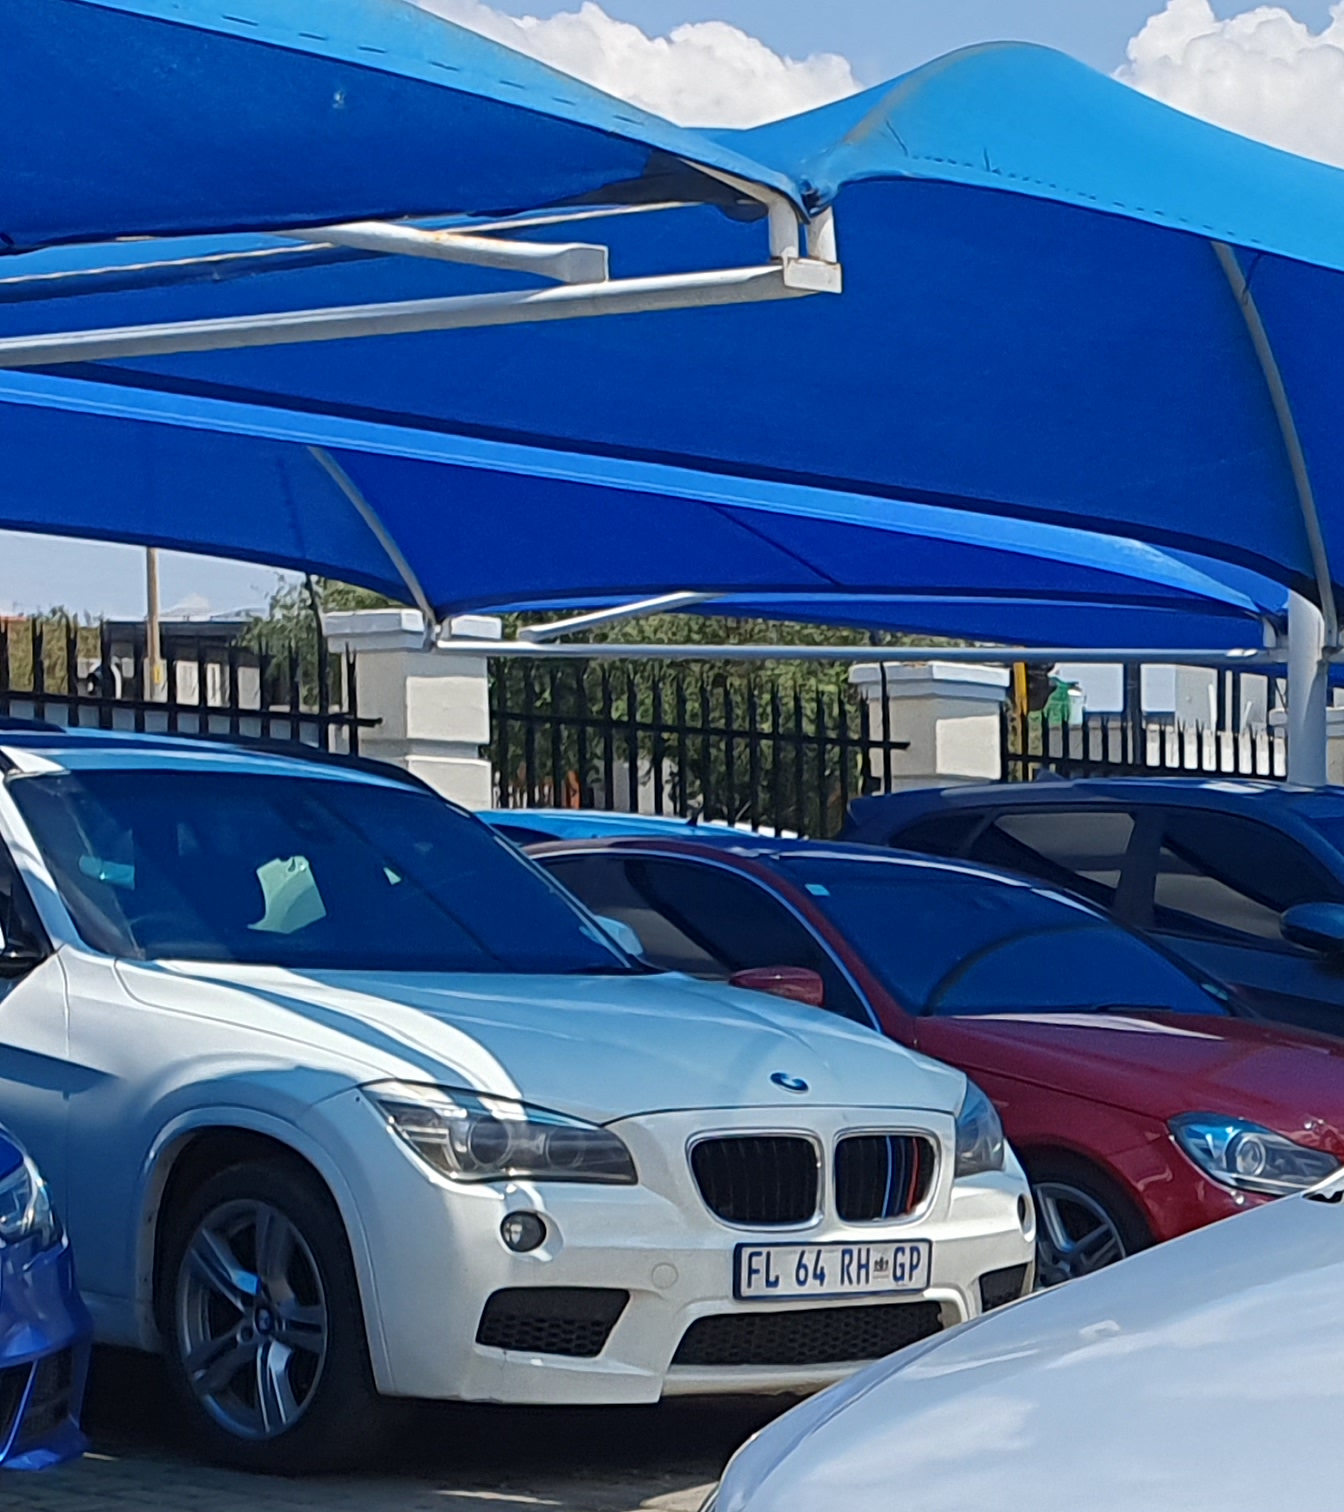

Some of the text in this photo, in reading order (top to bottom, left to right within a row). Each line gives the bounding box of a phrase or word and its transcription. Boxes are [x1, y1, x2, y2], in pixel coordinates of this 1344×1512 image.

[746, 1246, 922, 1289] FL 64 RH GP
